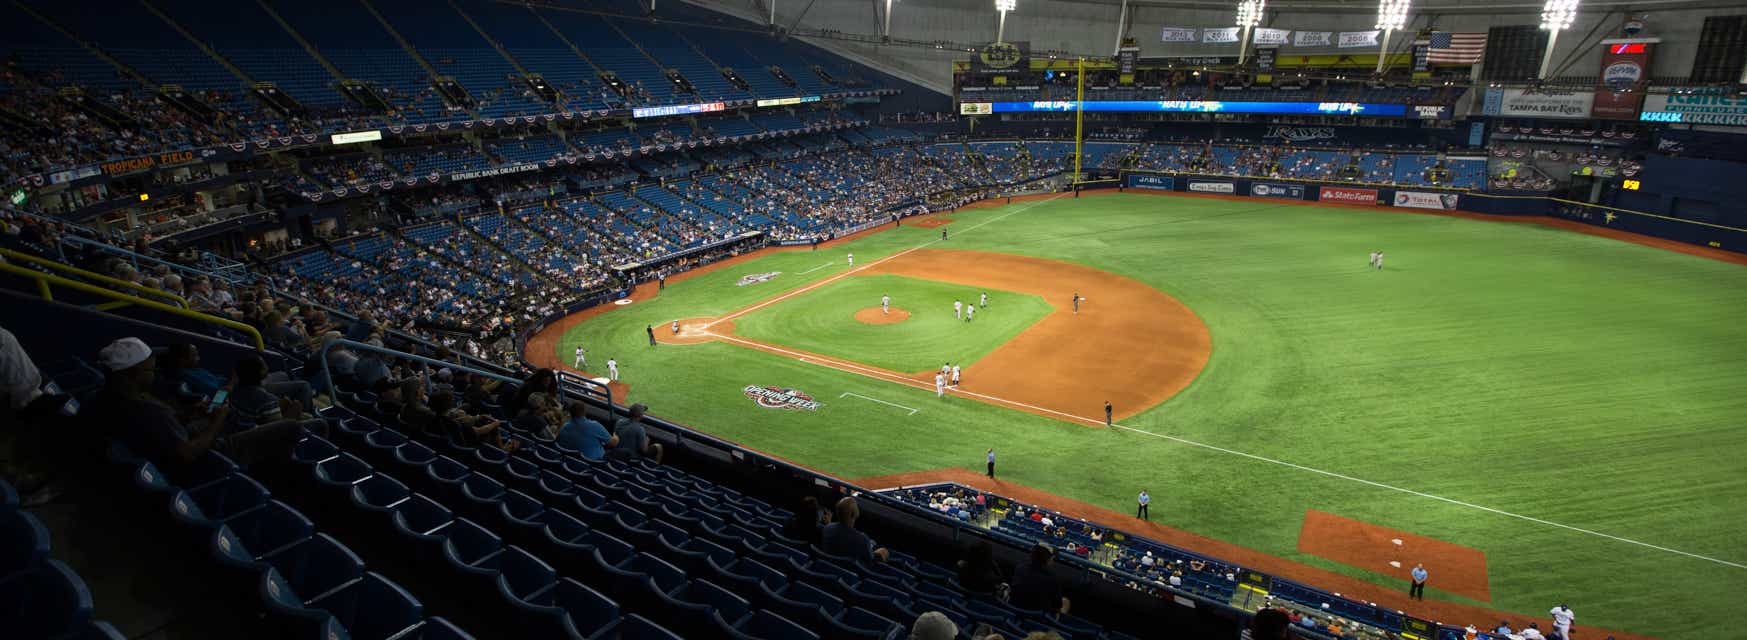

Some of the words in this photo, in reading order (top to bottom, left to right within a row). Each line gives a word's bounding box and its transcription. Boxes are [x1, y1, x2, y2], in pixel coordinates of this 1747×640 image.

[1415, 105, 1445, 113] REPUBLIC
[1509, 104, 1538, 113] TAMPA
[1540, 104, 1558, 113] BAY
[101, 157, 155, 176] TROPICANA
[160, 151, 193, 166] FIELD
[451, 171, 481, 181] REPUBLIC
[482, 167, 500, 177] BANK
[500, 165, 520, 175] DRAFT
[520, 163, 539, 172] ROOM
[744, 384, 791, 401] OPENING
[789, 396, 818, 412] WEEK
